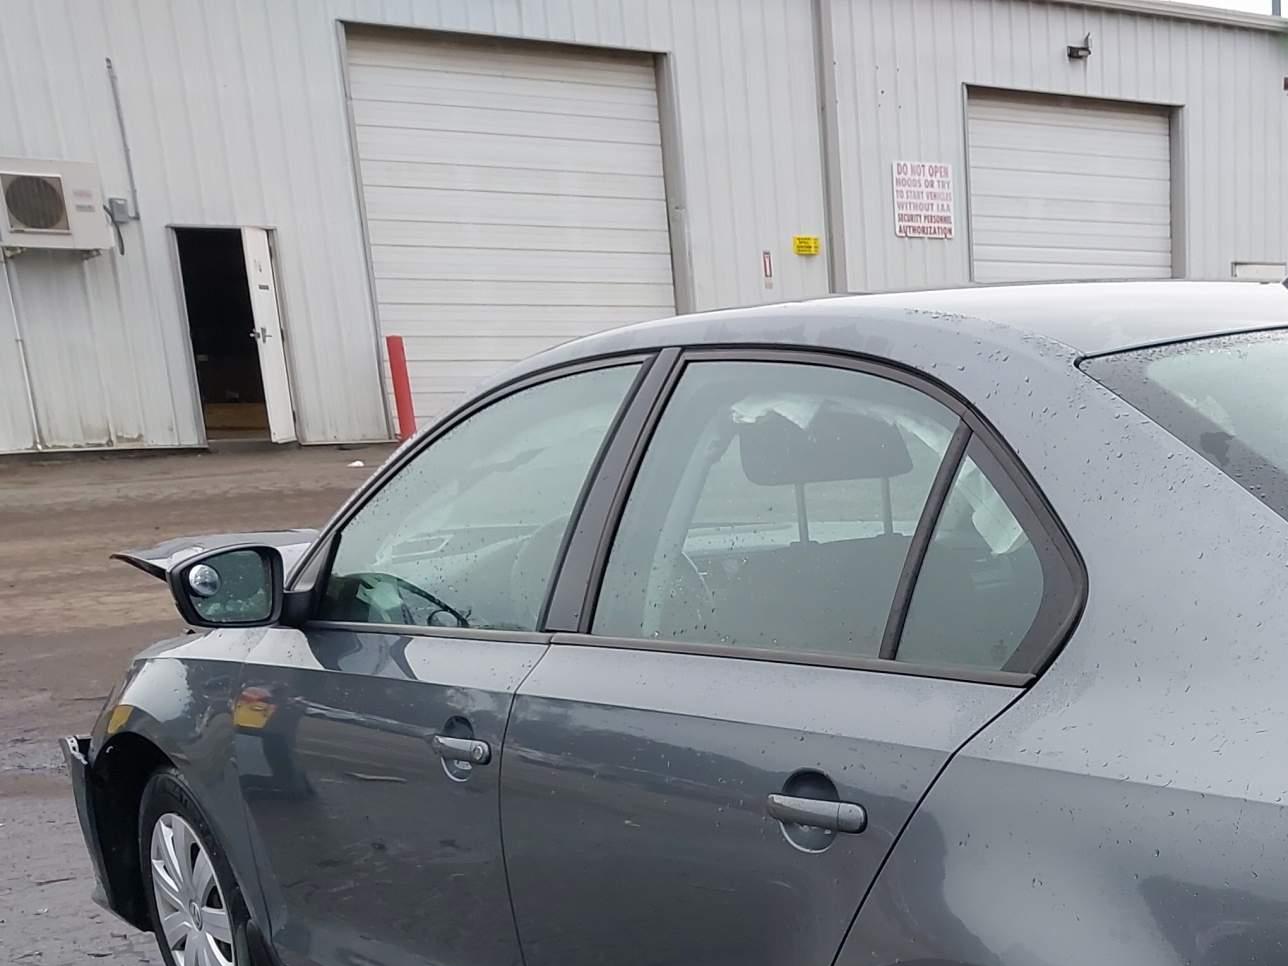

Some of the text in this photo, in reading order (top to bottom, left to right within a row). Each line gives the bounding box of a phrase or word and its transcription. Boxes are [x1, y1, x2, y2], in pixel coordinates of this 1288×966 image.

[897, 163, 949, 178] DO NOT OPEN
[896, 177, 950, 189] HOODS OR TRY
[896, 189, 905, 199] TO
[906, 190, 924, 200] START
[897, 201, 934, 212] WITHOUT
[897, 213, 922, 224] SECURITY
[898, 224, 952, 235] AUTHORIZATION
